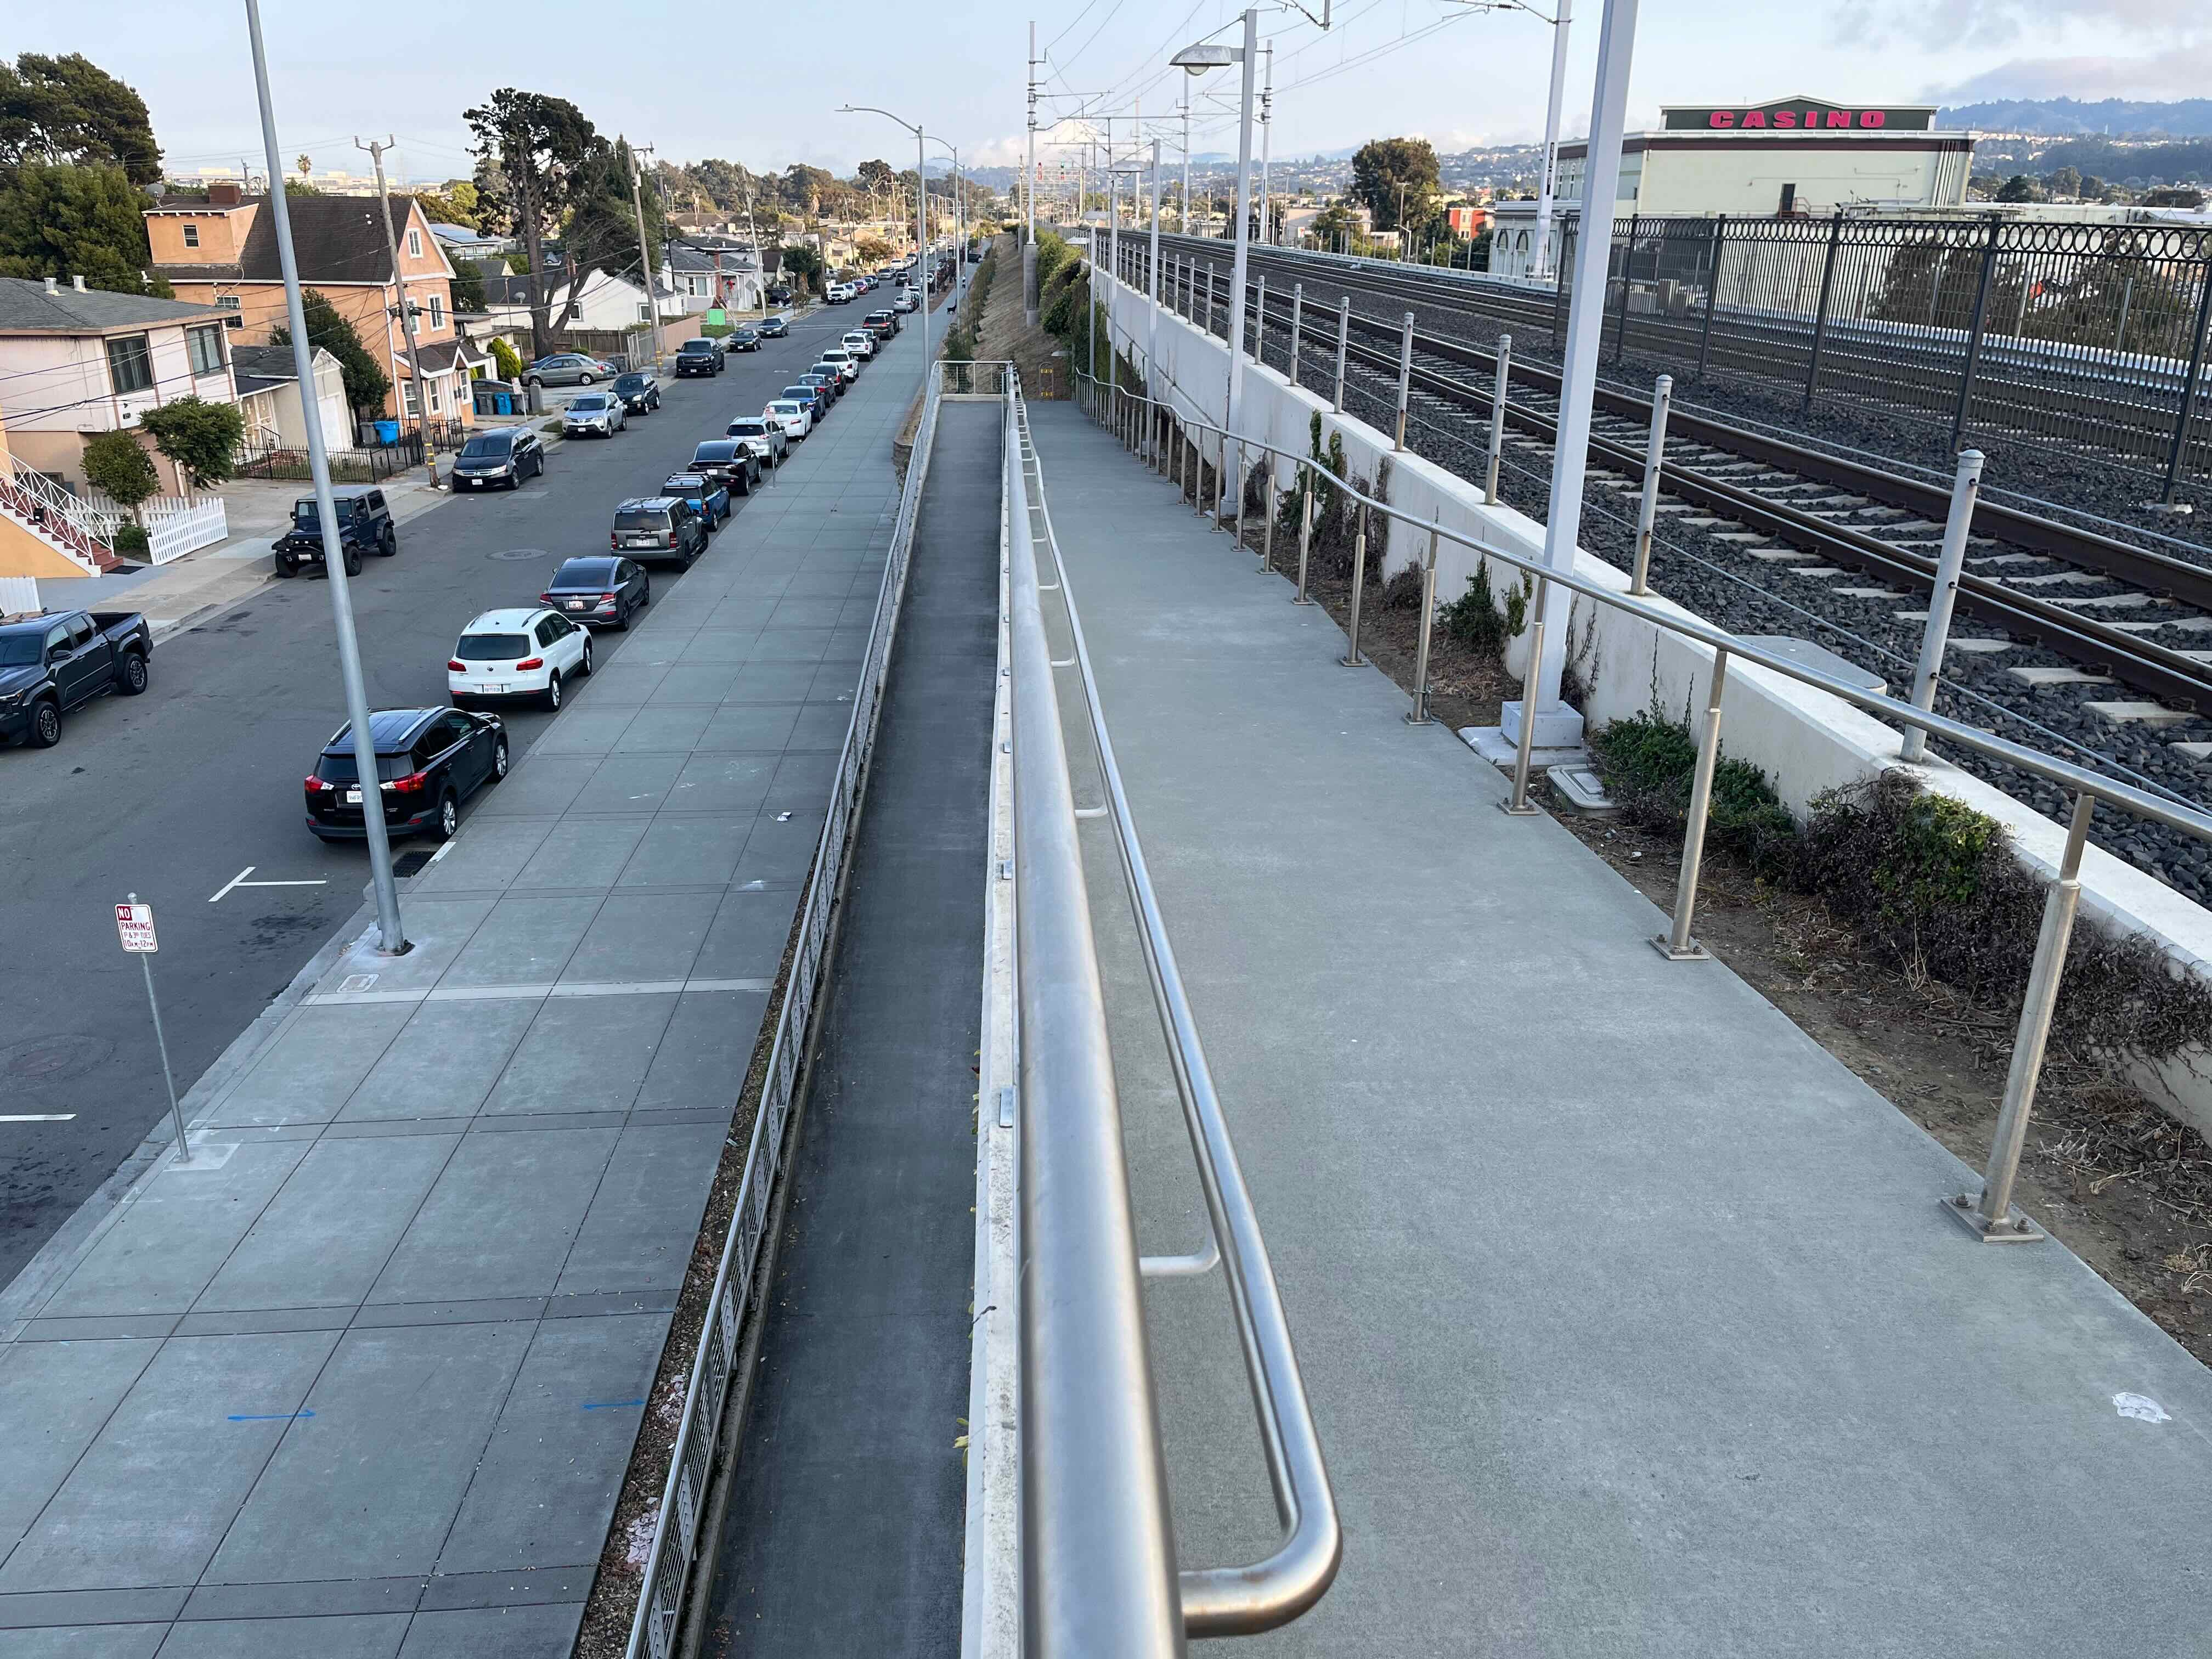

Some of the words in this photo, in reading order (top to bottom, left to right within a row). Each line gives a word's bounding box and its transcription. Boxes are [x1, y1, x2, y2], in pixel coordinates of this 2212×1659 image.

[1709, 111, 1885, 128] CASINO
[118, 908, 131, 918] NO
[121, 922, 150, 930] PARKING
